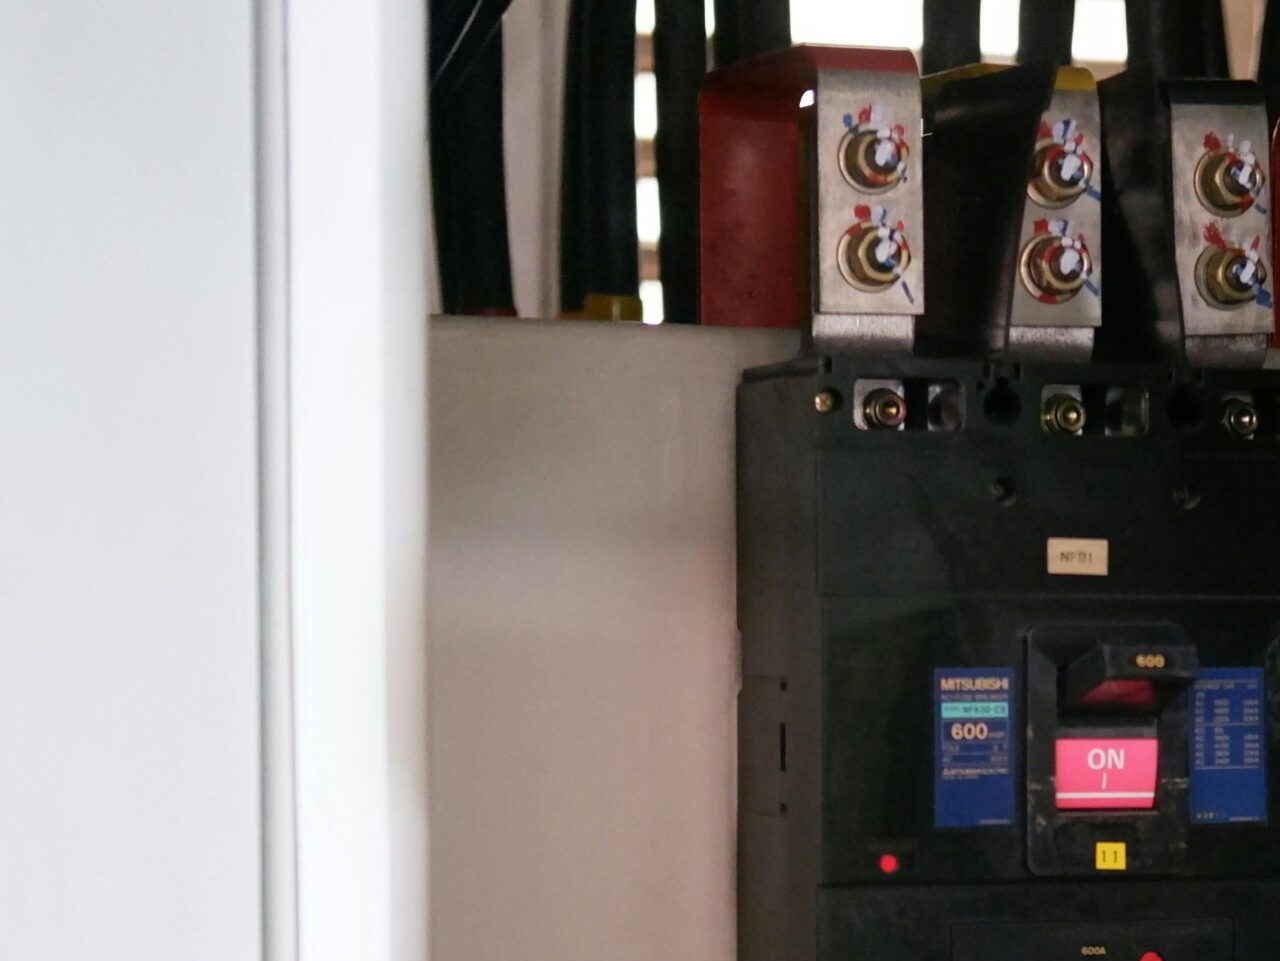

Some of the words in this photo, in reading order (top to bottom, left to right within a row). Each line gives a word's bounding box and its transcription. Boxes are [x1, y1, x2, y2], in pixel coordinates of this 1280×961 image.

[1136, 654, 1165, 668] 600
[941, 678, 1008, 691] MITSUBISHI
[951, 722, 988, 740] 600
[1087, 748, 1125, 770] ON
[1102, 850, 1118, 863] 11
[1081, 946, 1107, 956] 600A
